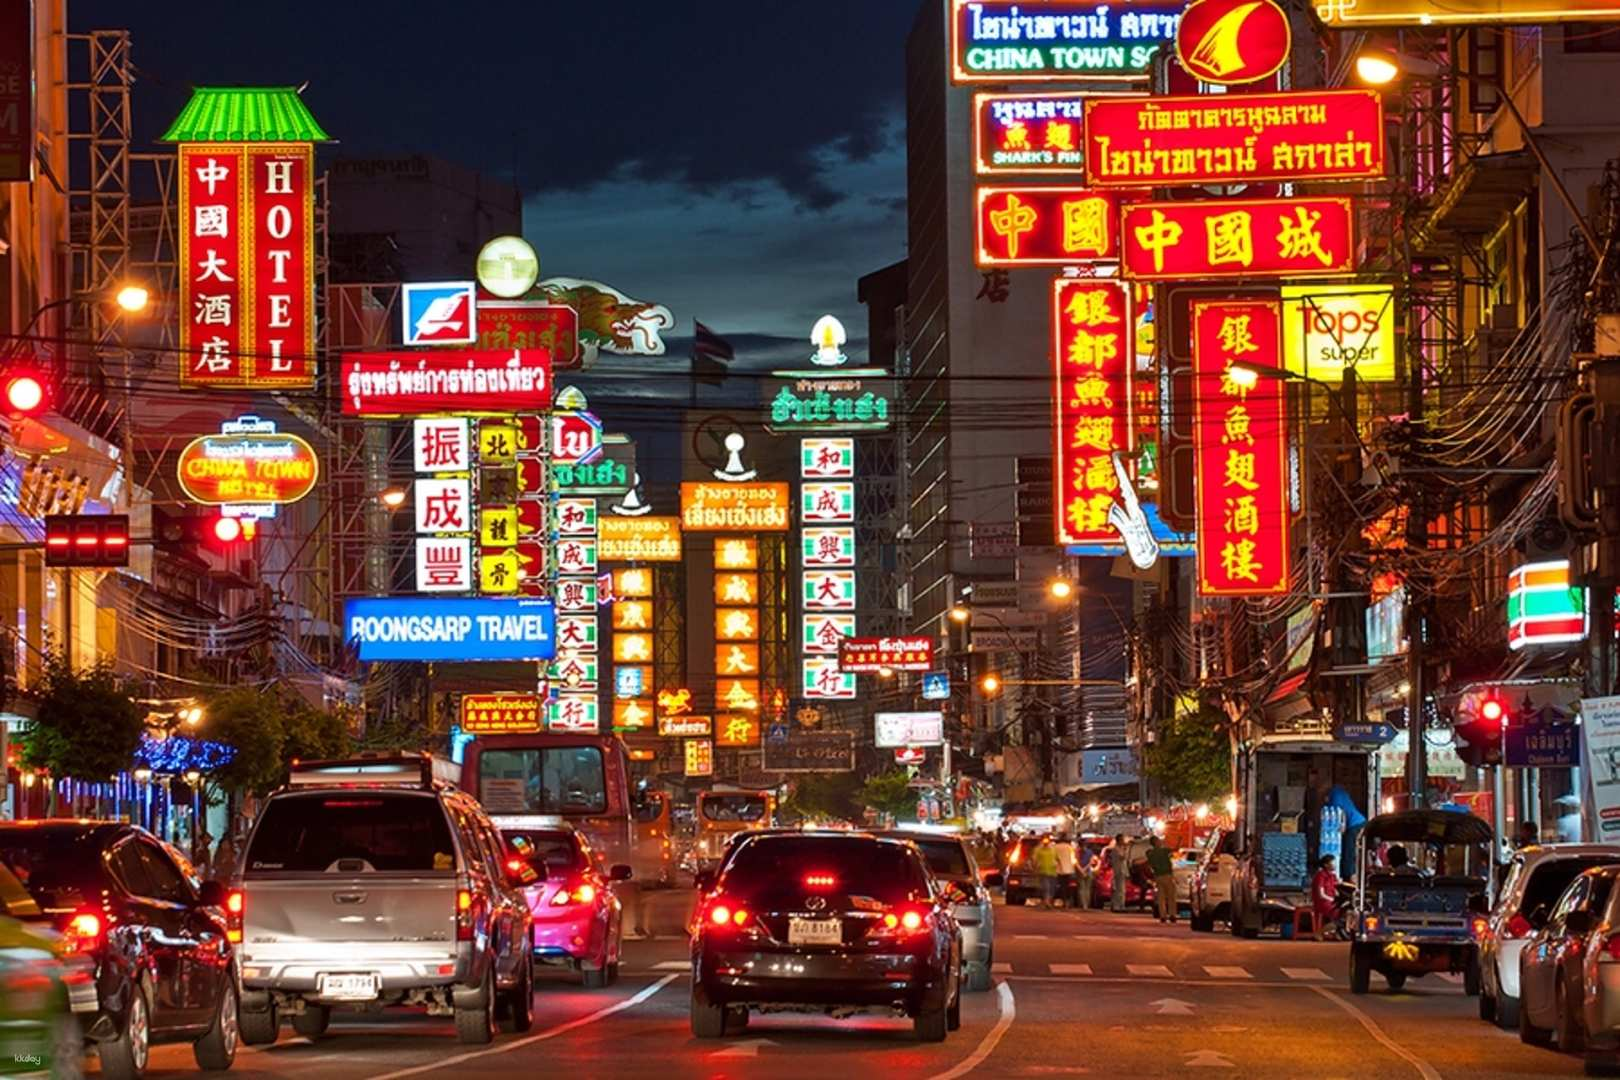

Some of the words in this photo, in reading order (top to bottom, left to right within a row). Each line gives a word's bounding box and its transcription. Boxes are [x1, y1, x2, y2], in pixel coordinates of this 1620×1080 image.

[967, 48, 1045, 69] CHINA
[1050, 47, 1124, 69] TOWN
[1138, 103, 1327, 133] ภัตตาคารหูฉลาม
[993, 151, 1054, 164] SHARK'S
[1094, 134, 1258, 177] ไชน่าทาวน์
[1272, 130, 1373, 170] สกาล่า
[989, 193, 1109, 257] 中國
[1135, 206, 1333, 273] 中國城
[194, 159, 234, 372] 中國大酒店
[265, 161, 293, 371] HOTEL
[1296, 306, 1379, 344] Tops
[1320, 346, 1378, 365] super
[422, 427, 462, 586] 振成豐
[815, 446, 843, 695] 和成興大金行
[351, 616, 472, 642] ROONGSARP
[476, 614, 548, 641] TRAVEL
[1379, 726, 1388, 737] 2
